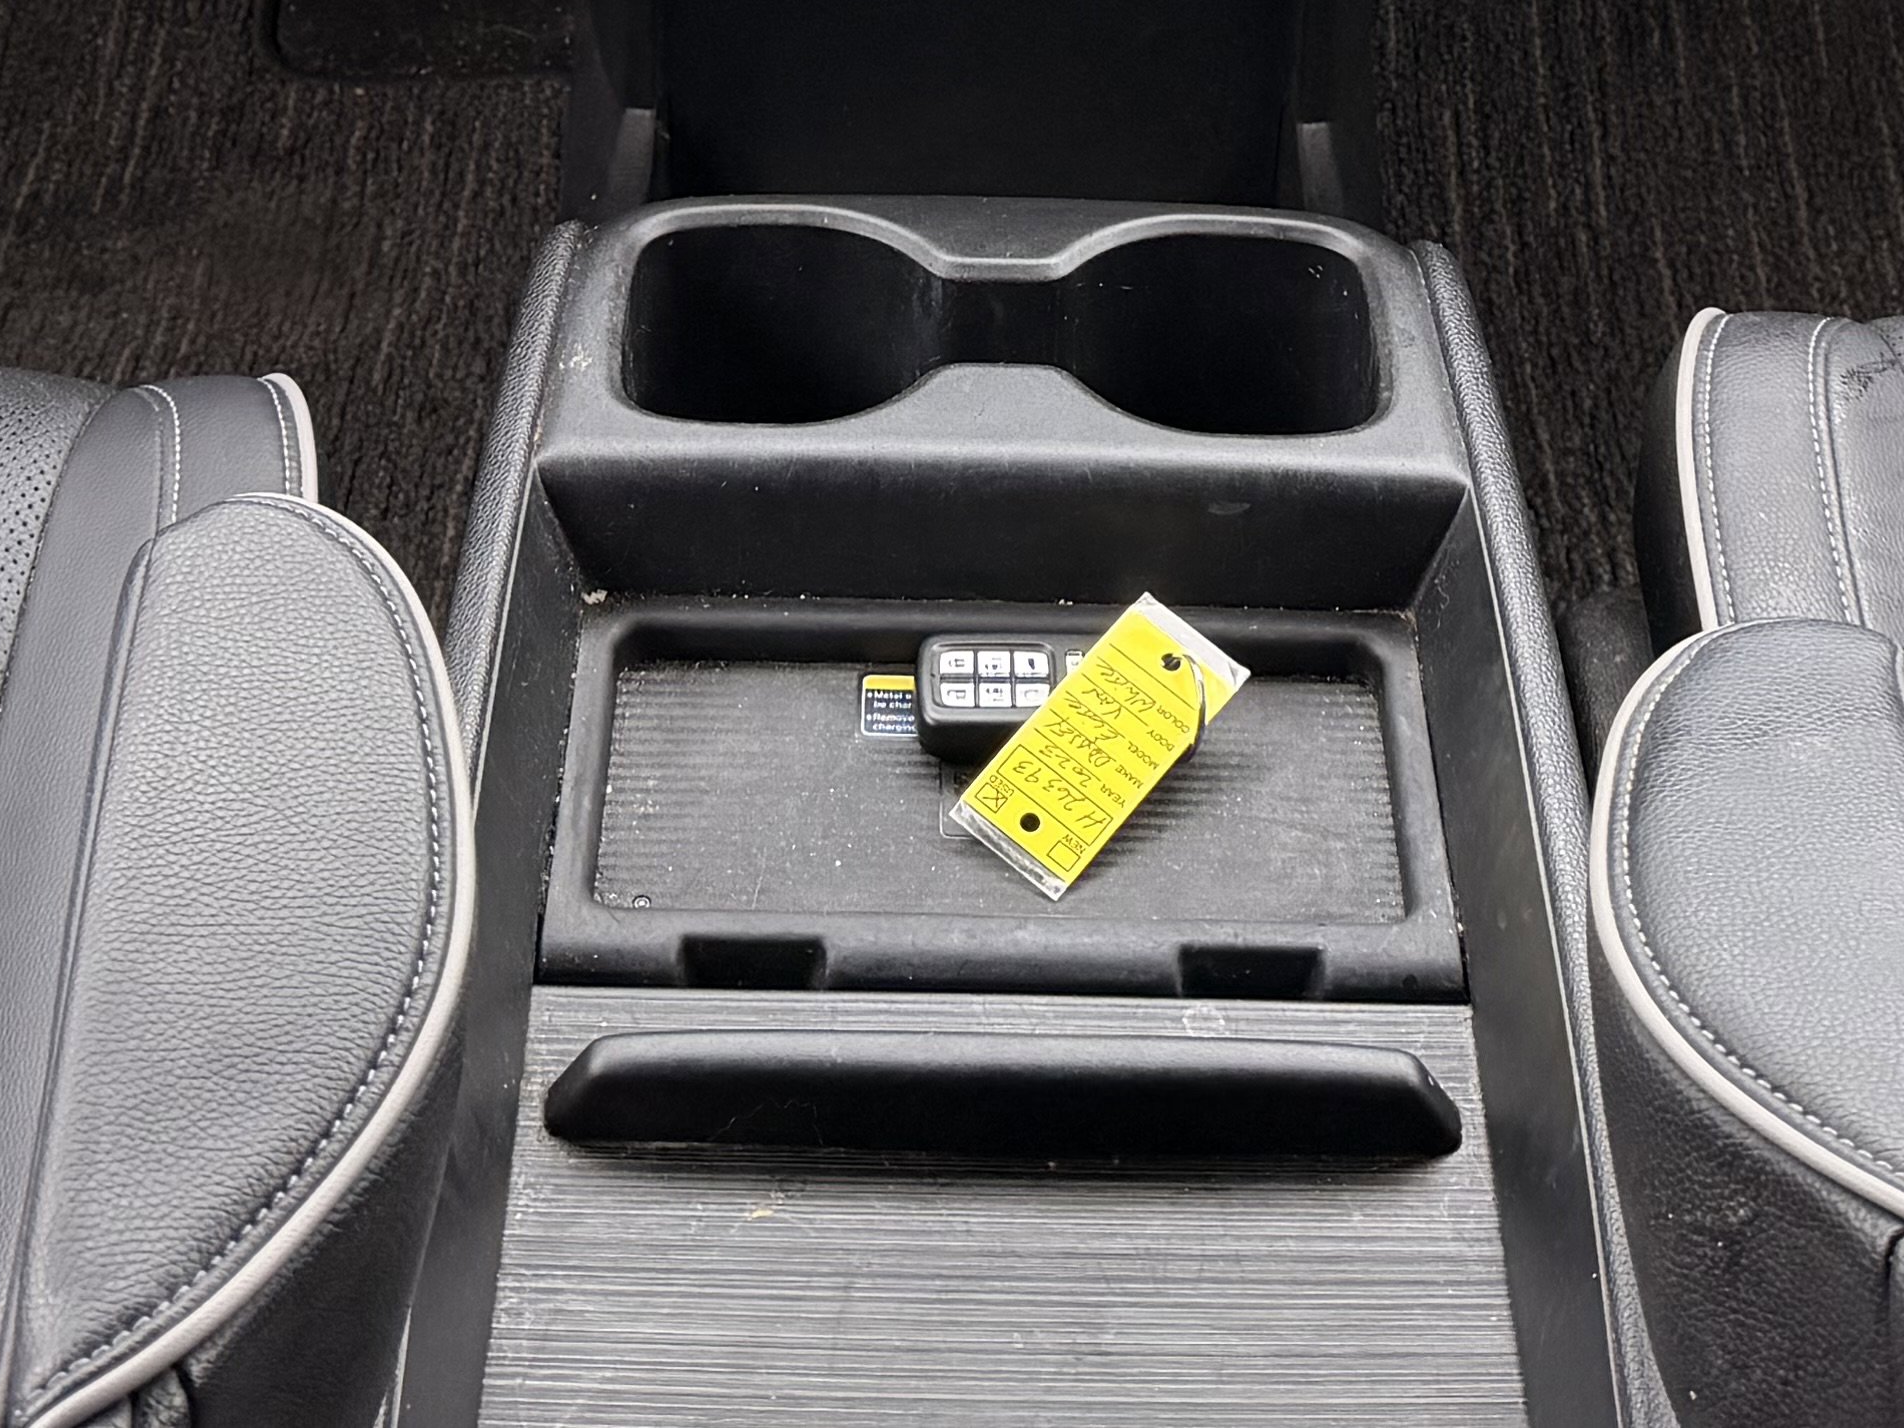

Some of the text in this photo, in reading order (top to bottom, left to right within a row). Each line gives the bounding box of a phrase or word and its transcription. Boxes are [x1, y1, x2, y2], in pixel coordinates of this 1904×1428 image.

[889, 701, 912, 709] char
[1154, 705, 1189, 734] COLOR
[1124, 741, 1159, 769] MODEL
[1114, 764, 1143, 788] MAKE
[1099, 784, 1126, 807] YEAR
[1061, 833, 1086, 854] NEW
